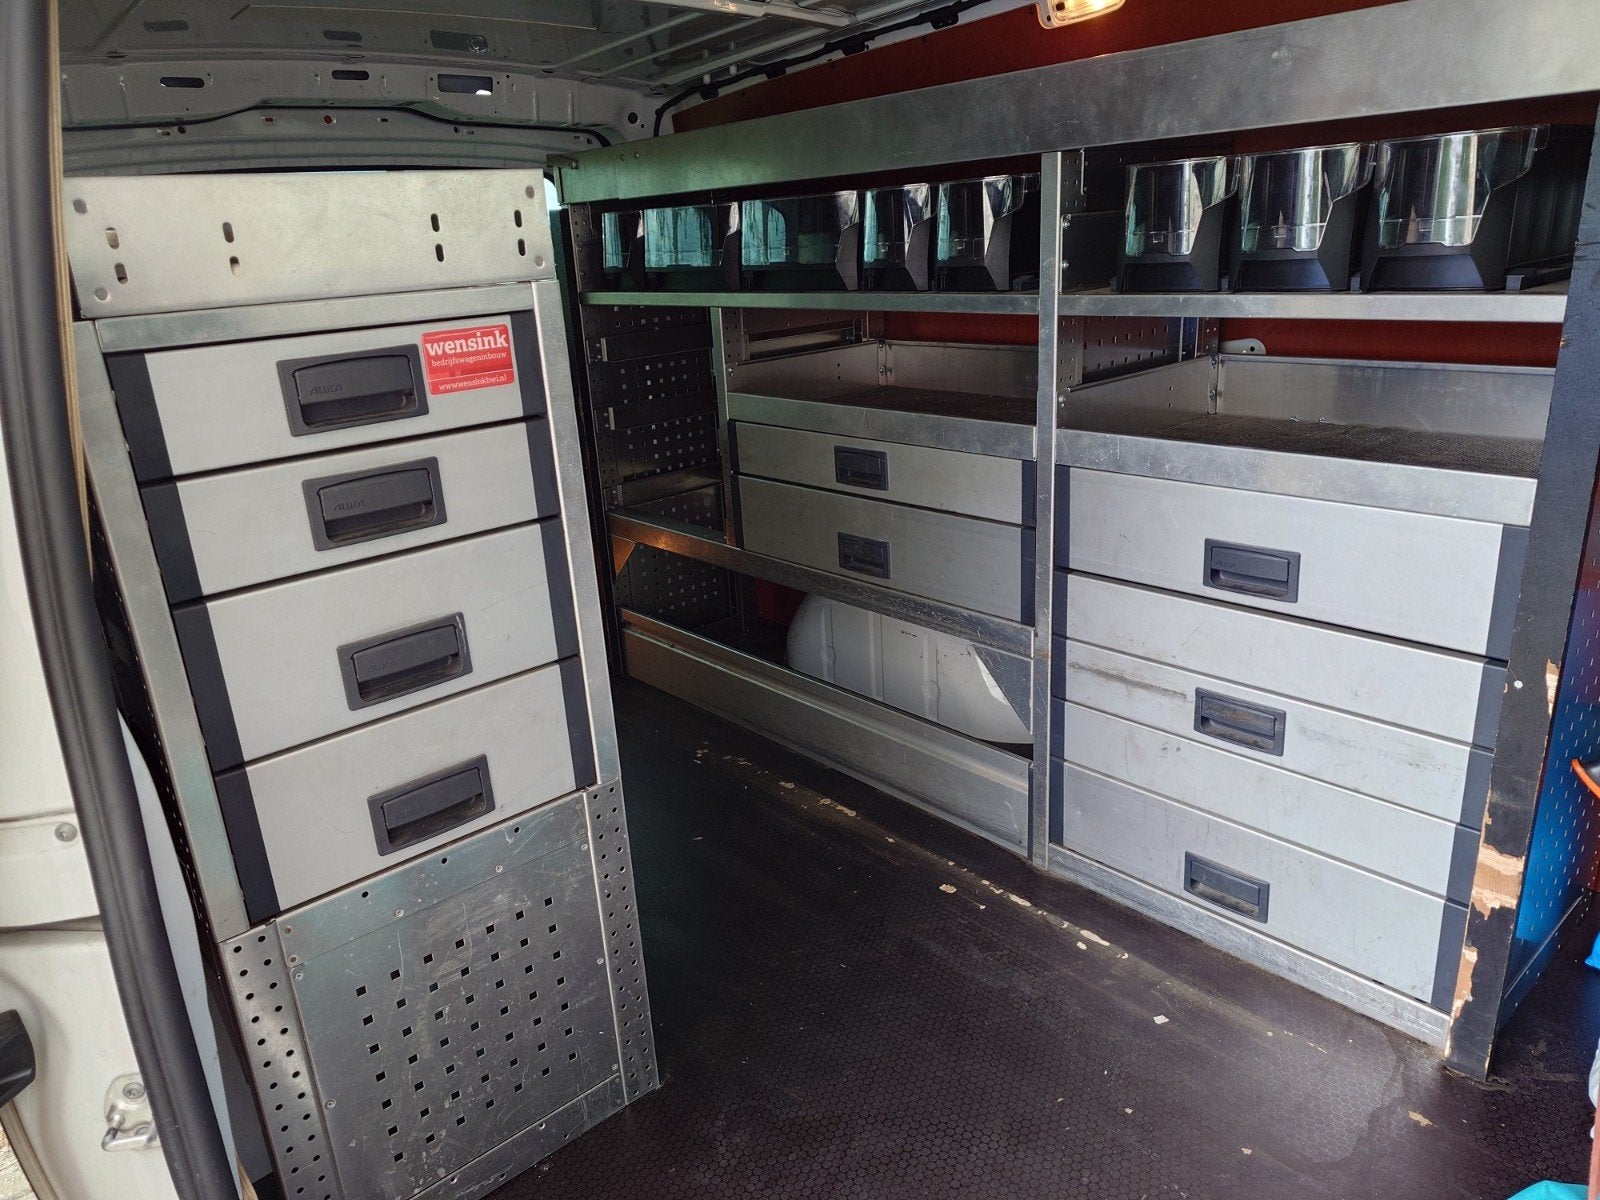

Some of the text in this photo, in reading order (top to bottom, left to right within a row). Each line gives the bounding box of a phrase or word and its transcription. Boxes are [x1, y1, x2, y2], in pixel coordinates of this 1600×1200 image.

[425, 330, 508, 356] wensink
[431, 352, 507, 367] bedrijfswageninbouw
[310, 384, 343, 395] ALUCA
[334, 499, 366, 512] ALUCA
